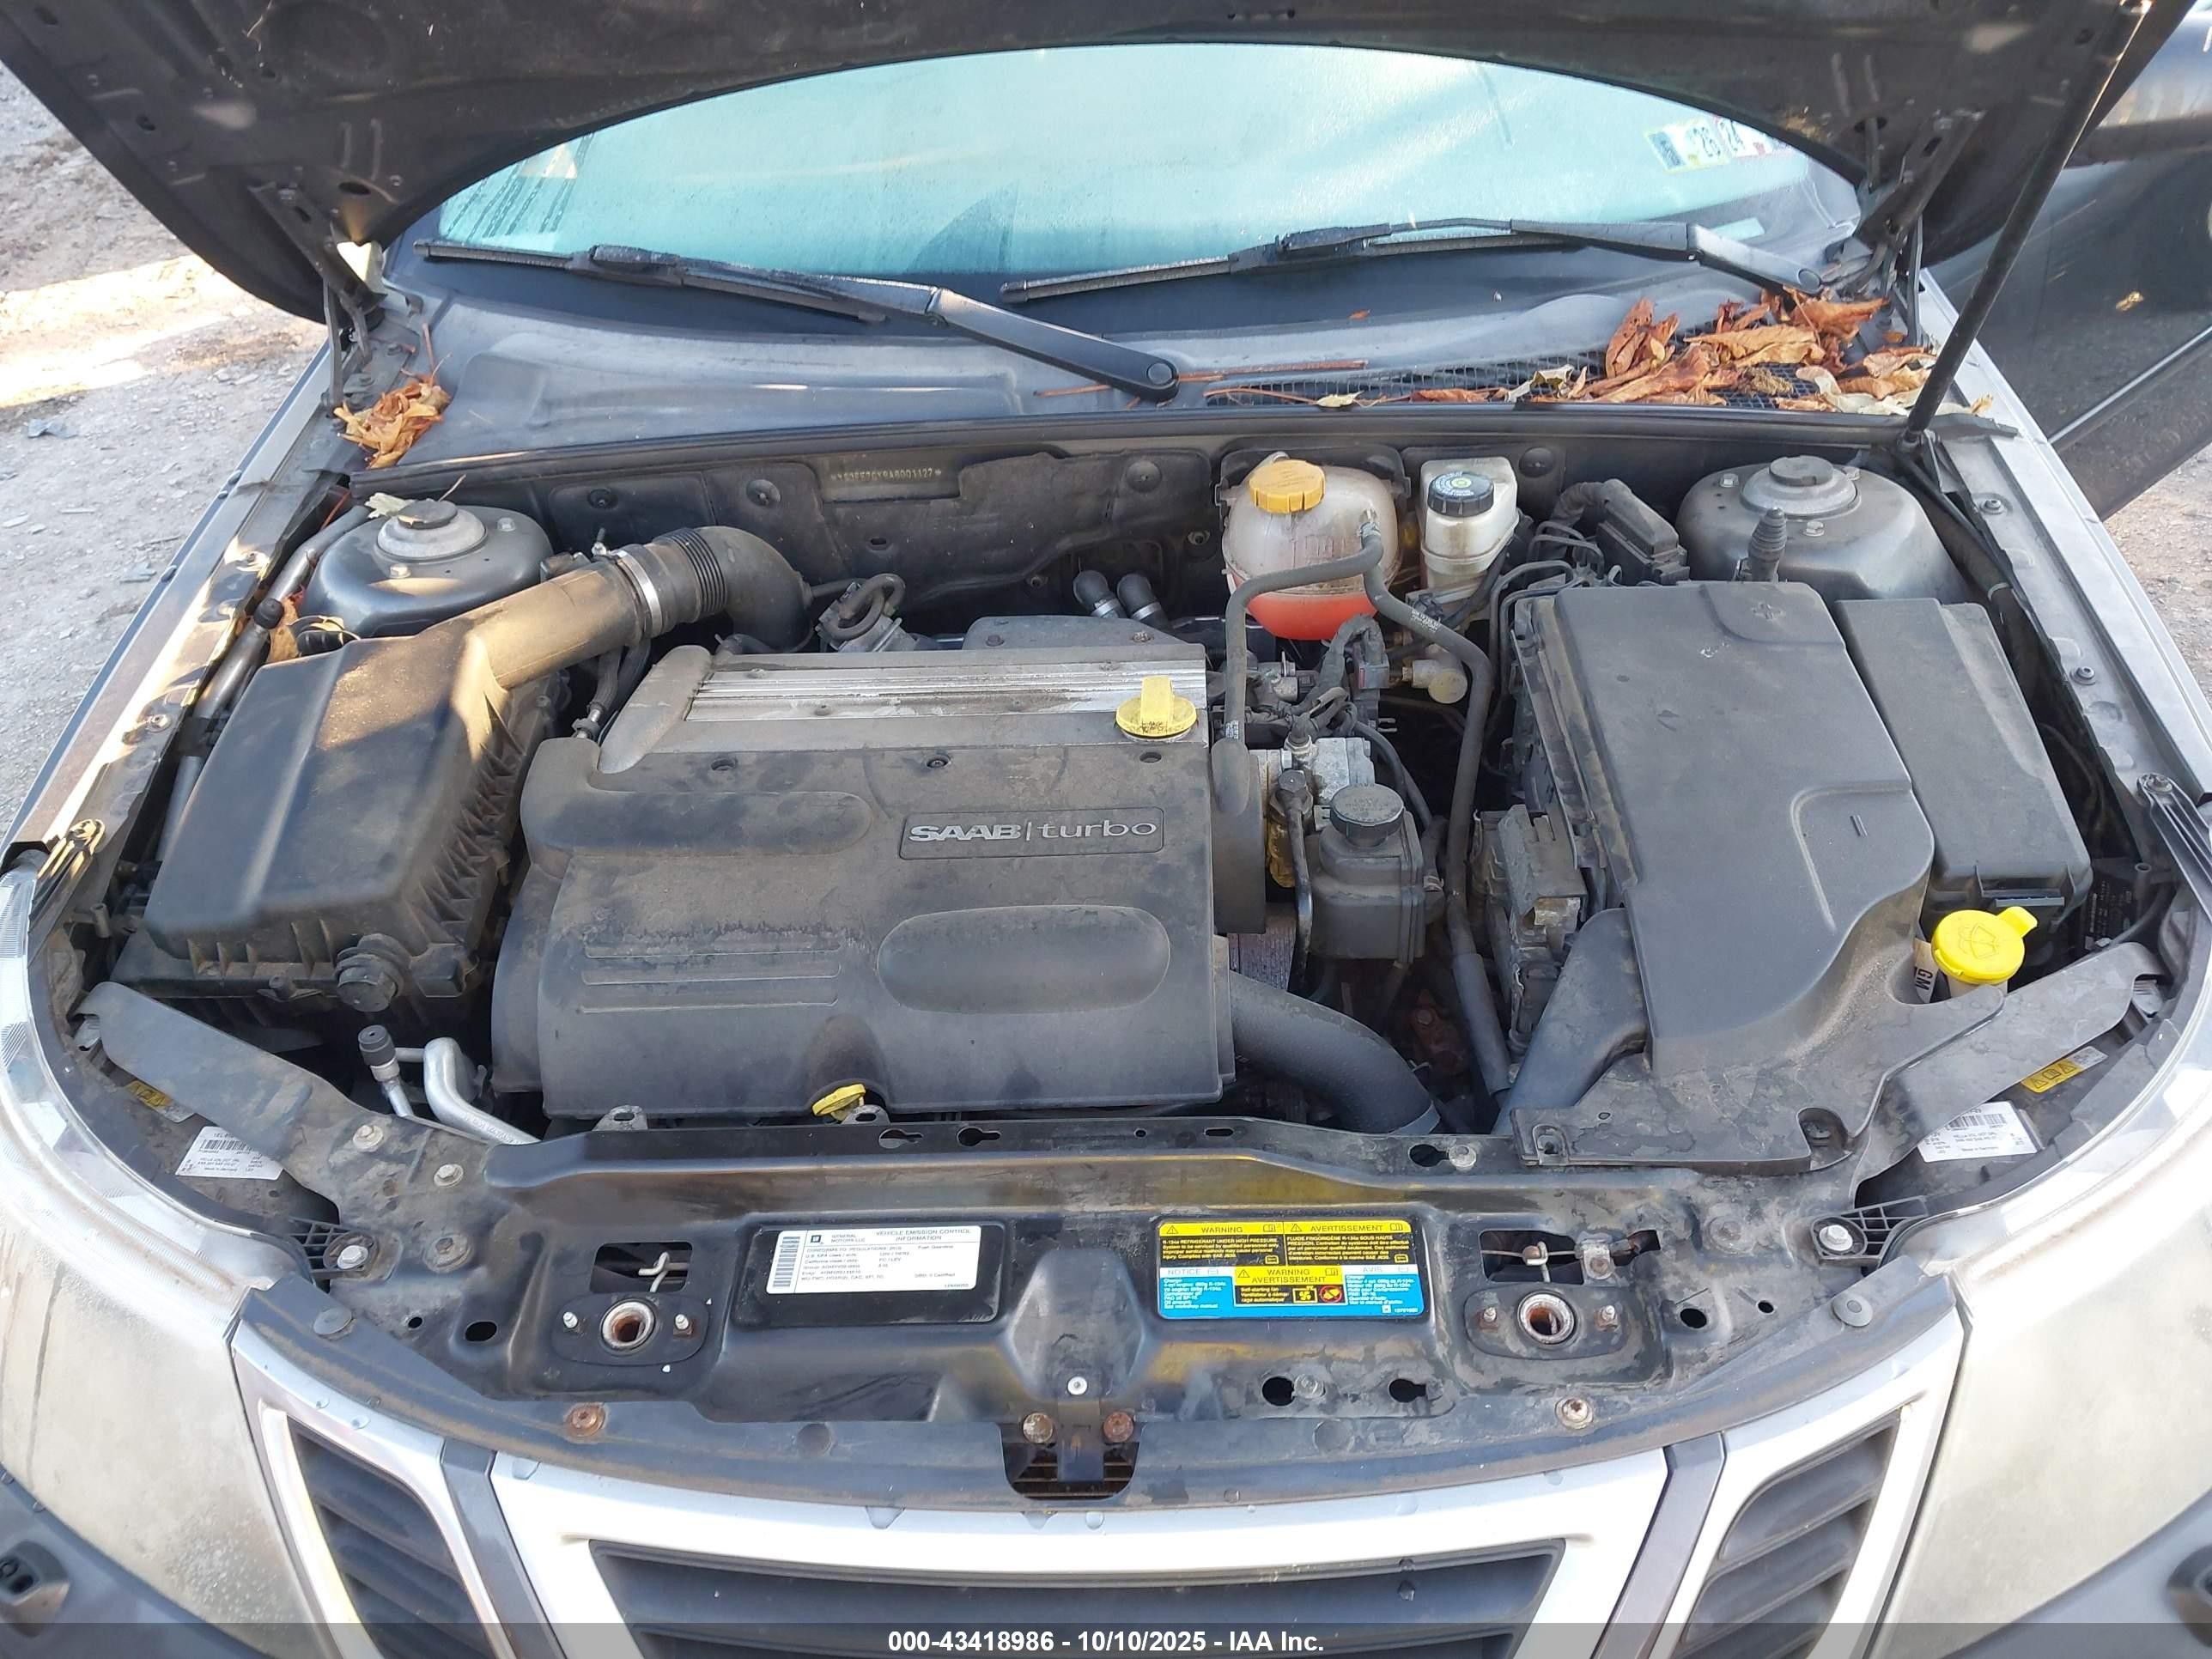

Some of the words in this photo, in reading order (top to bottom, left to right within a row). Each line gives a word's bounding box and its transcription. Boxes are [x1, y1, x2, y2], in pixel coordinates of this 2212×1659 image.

[908, 824, 1022, 842] SAAB
[1037, 820, 1157, 839] turbo
[1915, 968, 1933, 991] GM
